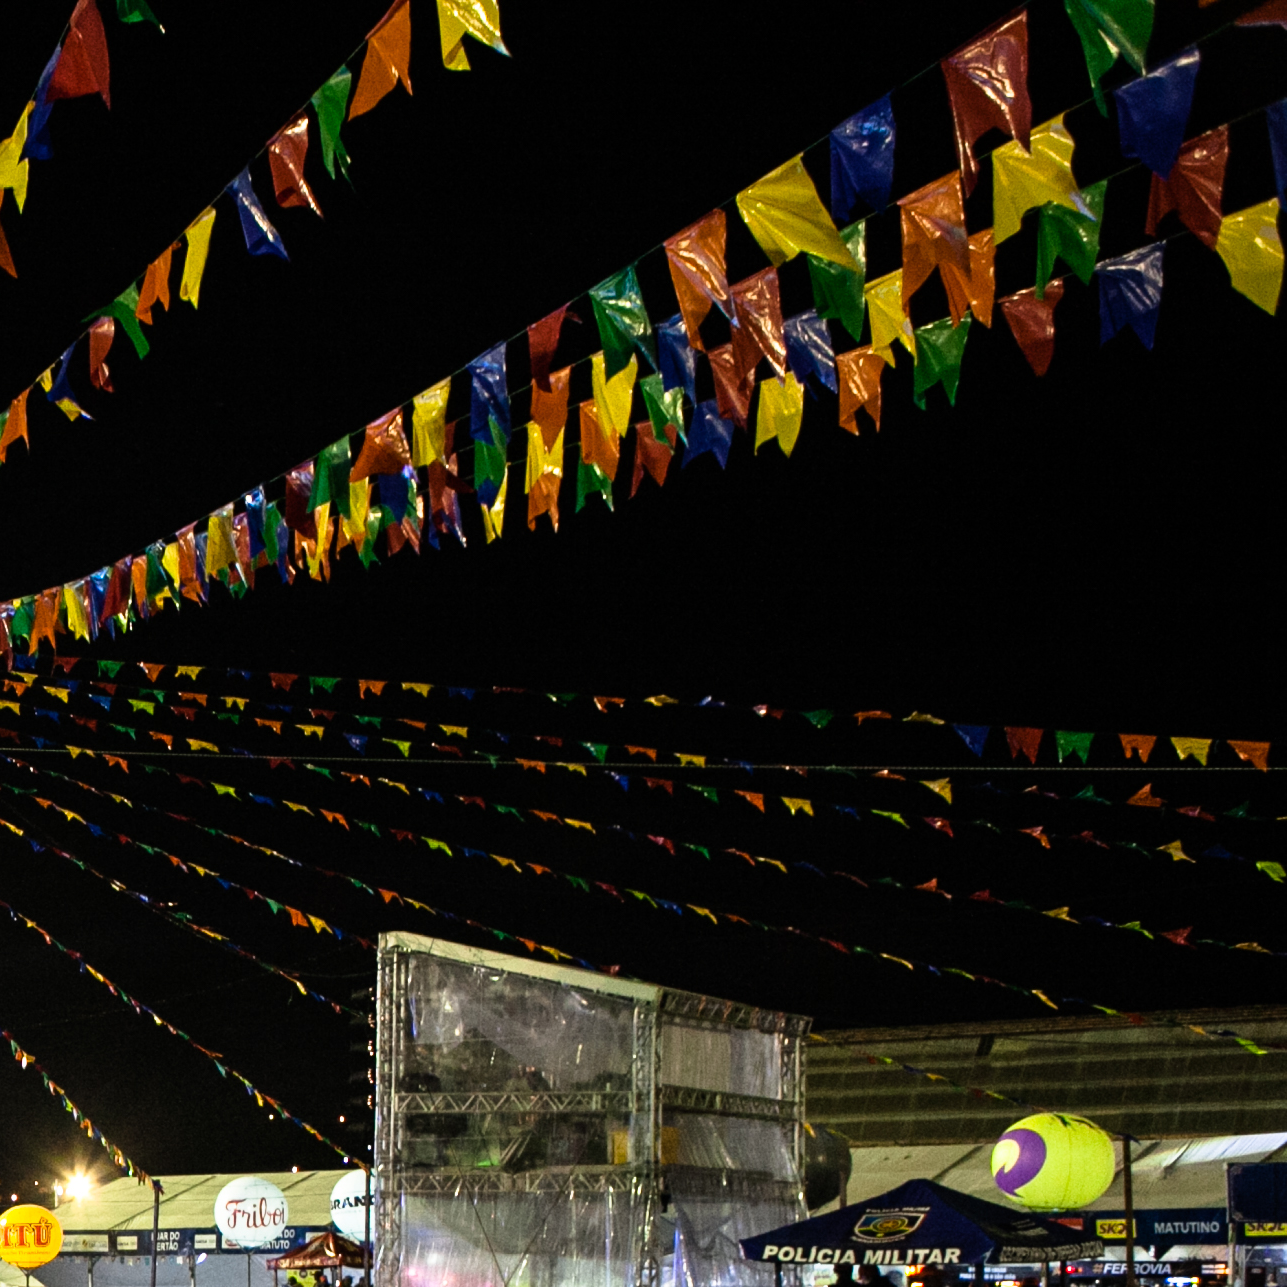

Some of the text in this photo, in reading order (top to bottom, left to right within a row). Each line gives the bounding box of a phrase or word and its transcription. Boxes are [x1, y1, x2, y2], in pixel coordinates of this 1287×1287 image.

[226, 1197, 286, 1229] Friboi
[1099, 1221, 1220, 1235] SKO MATUTINO
[156, 1240, 179, 1251] ERTÃO
[762, 1244, 962, 1265] POLÍCIA MILITAR
